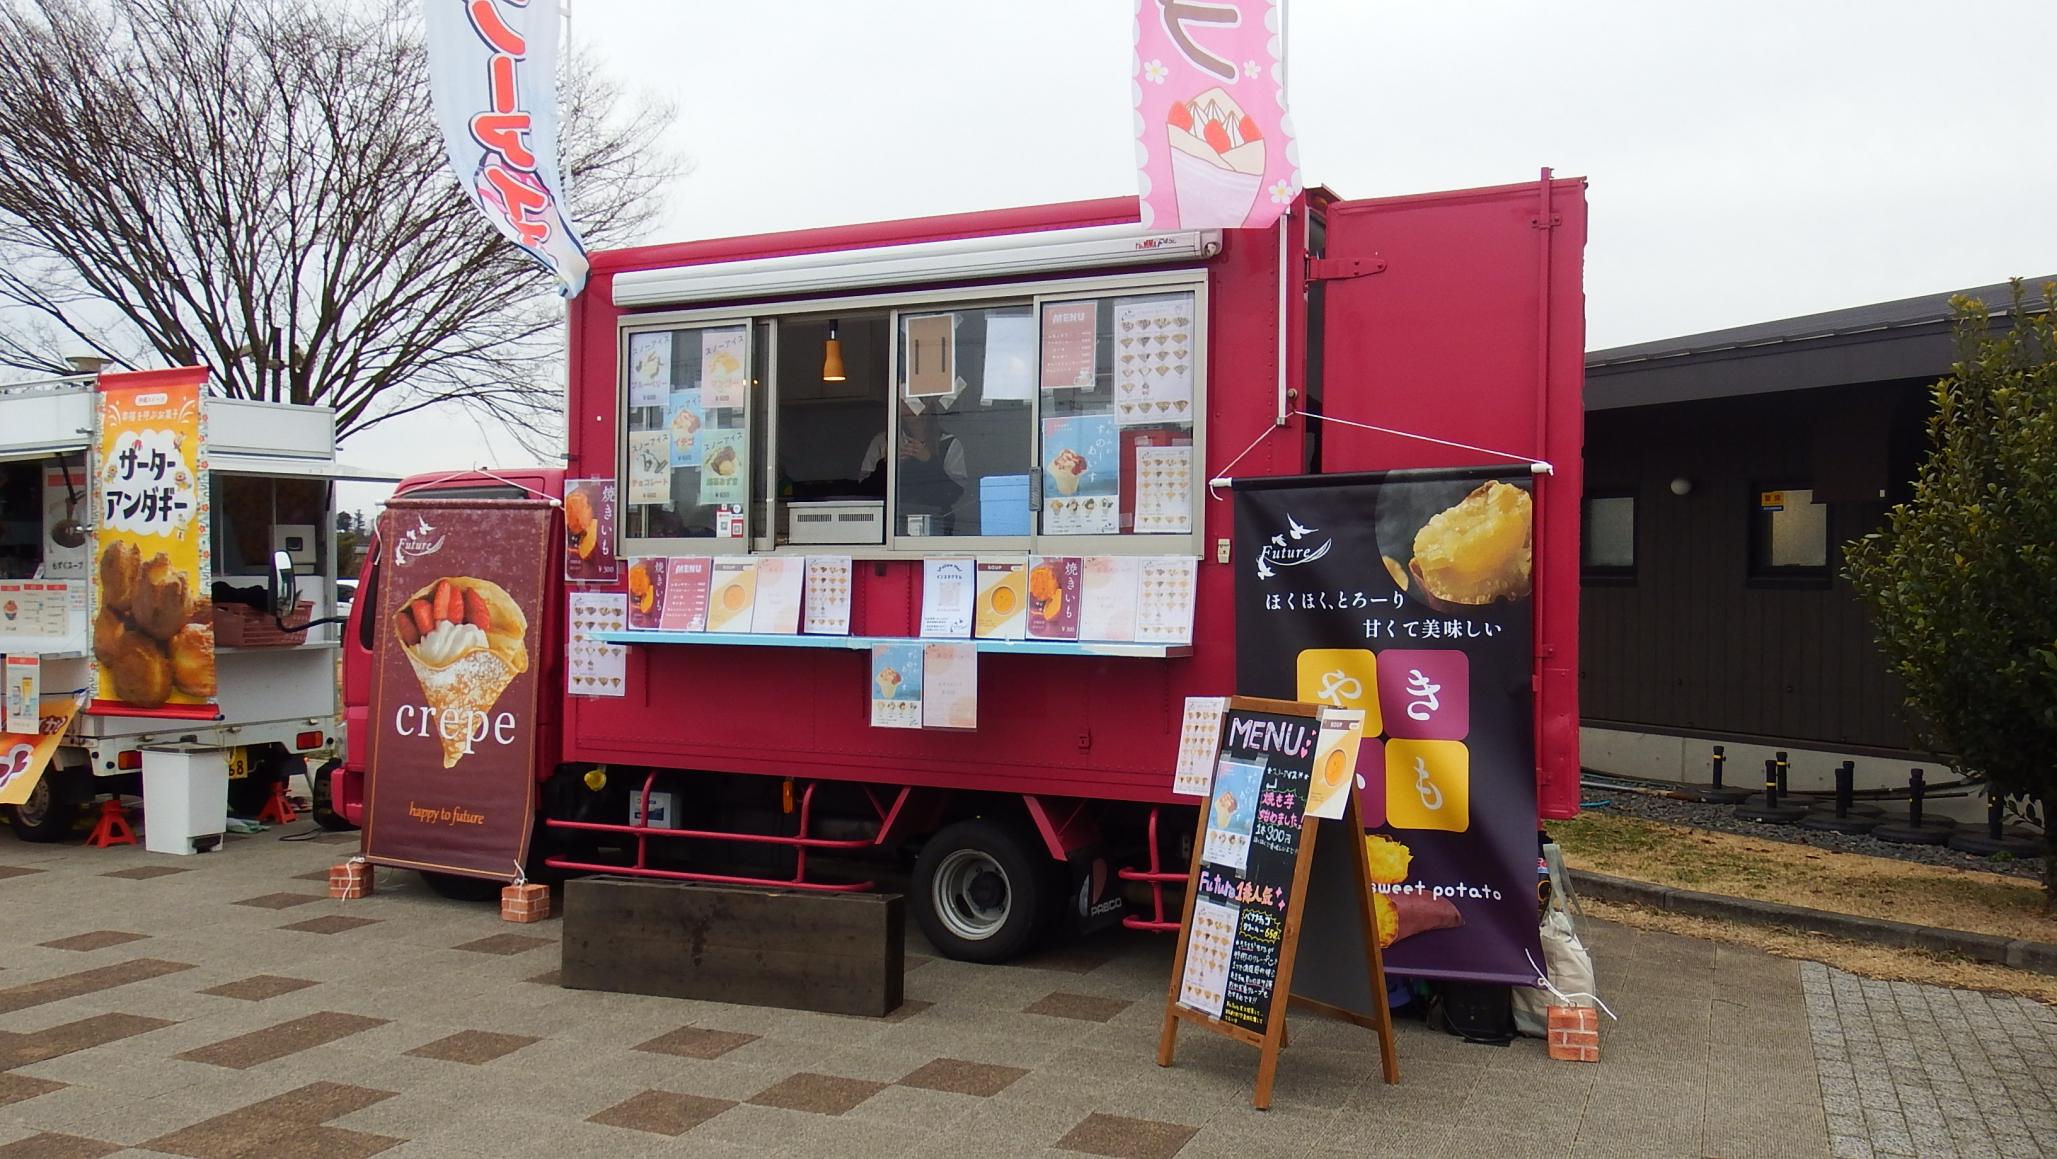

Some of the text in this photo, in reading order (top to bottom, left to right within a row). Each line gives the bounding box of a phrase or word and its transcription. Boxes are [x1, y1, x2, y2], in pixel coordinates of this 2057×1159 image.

[1051, 312, 1086, 325] MENU
[106, 486, 188, 522] アンダギー
[601, 485, 615, 556] 焼きいも
[399, 537, 432, 550] Future
[1260, 545, 1311, 561] Future
[675, 564, 703, 575] MENU
[1064, 561, 1079, 619] 焼きいも
[1265, 590, 1404, 611] ほくほく、とろーり
[1362, 618, 1502, 640] 甘くて美味しい
[1228, 717, 1306, 756] MENU
[1262, 791, 1295, 810] 焼き芋
[408, 801, 485, 826] happy to future
[1198, 871, 1236, 899] Future
[1370, 880, 1502, 901] sweet potato
